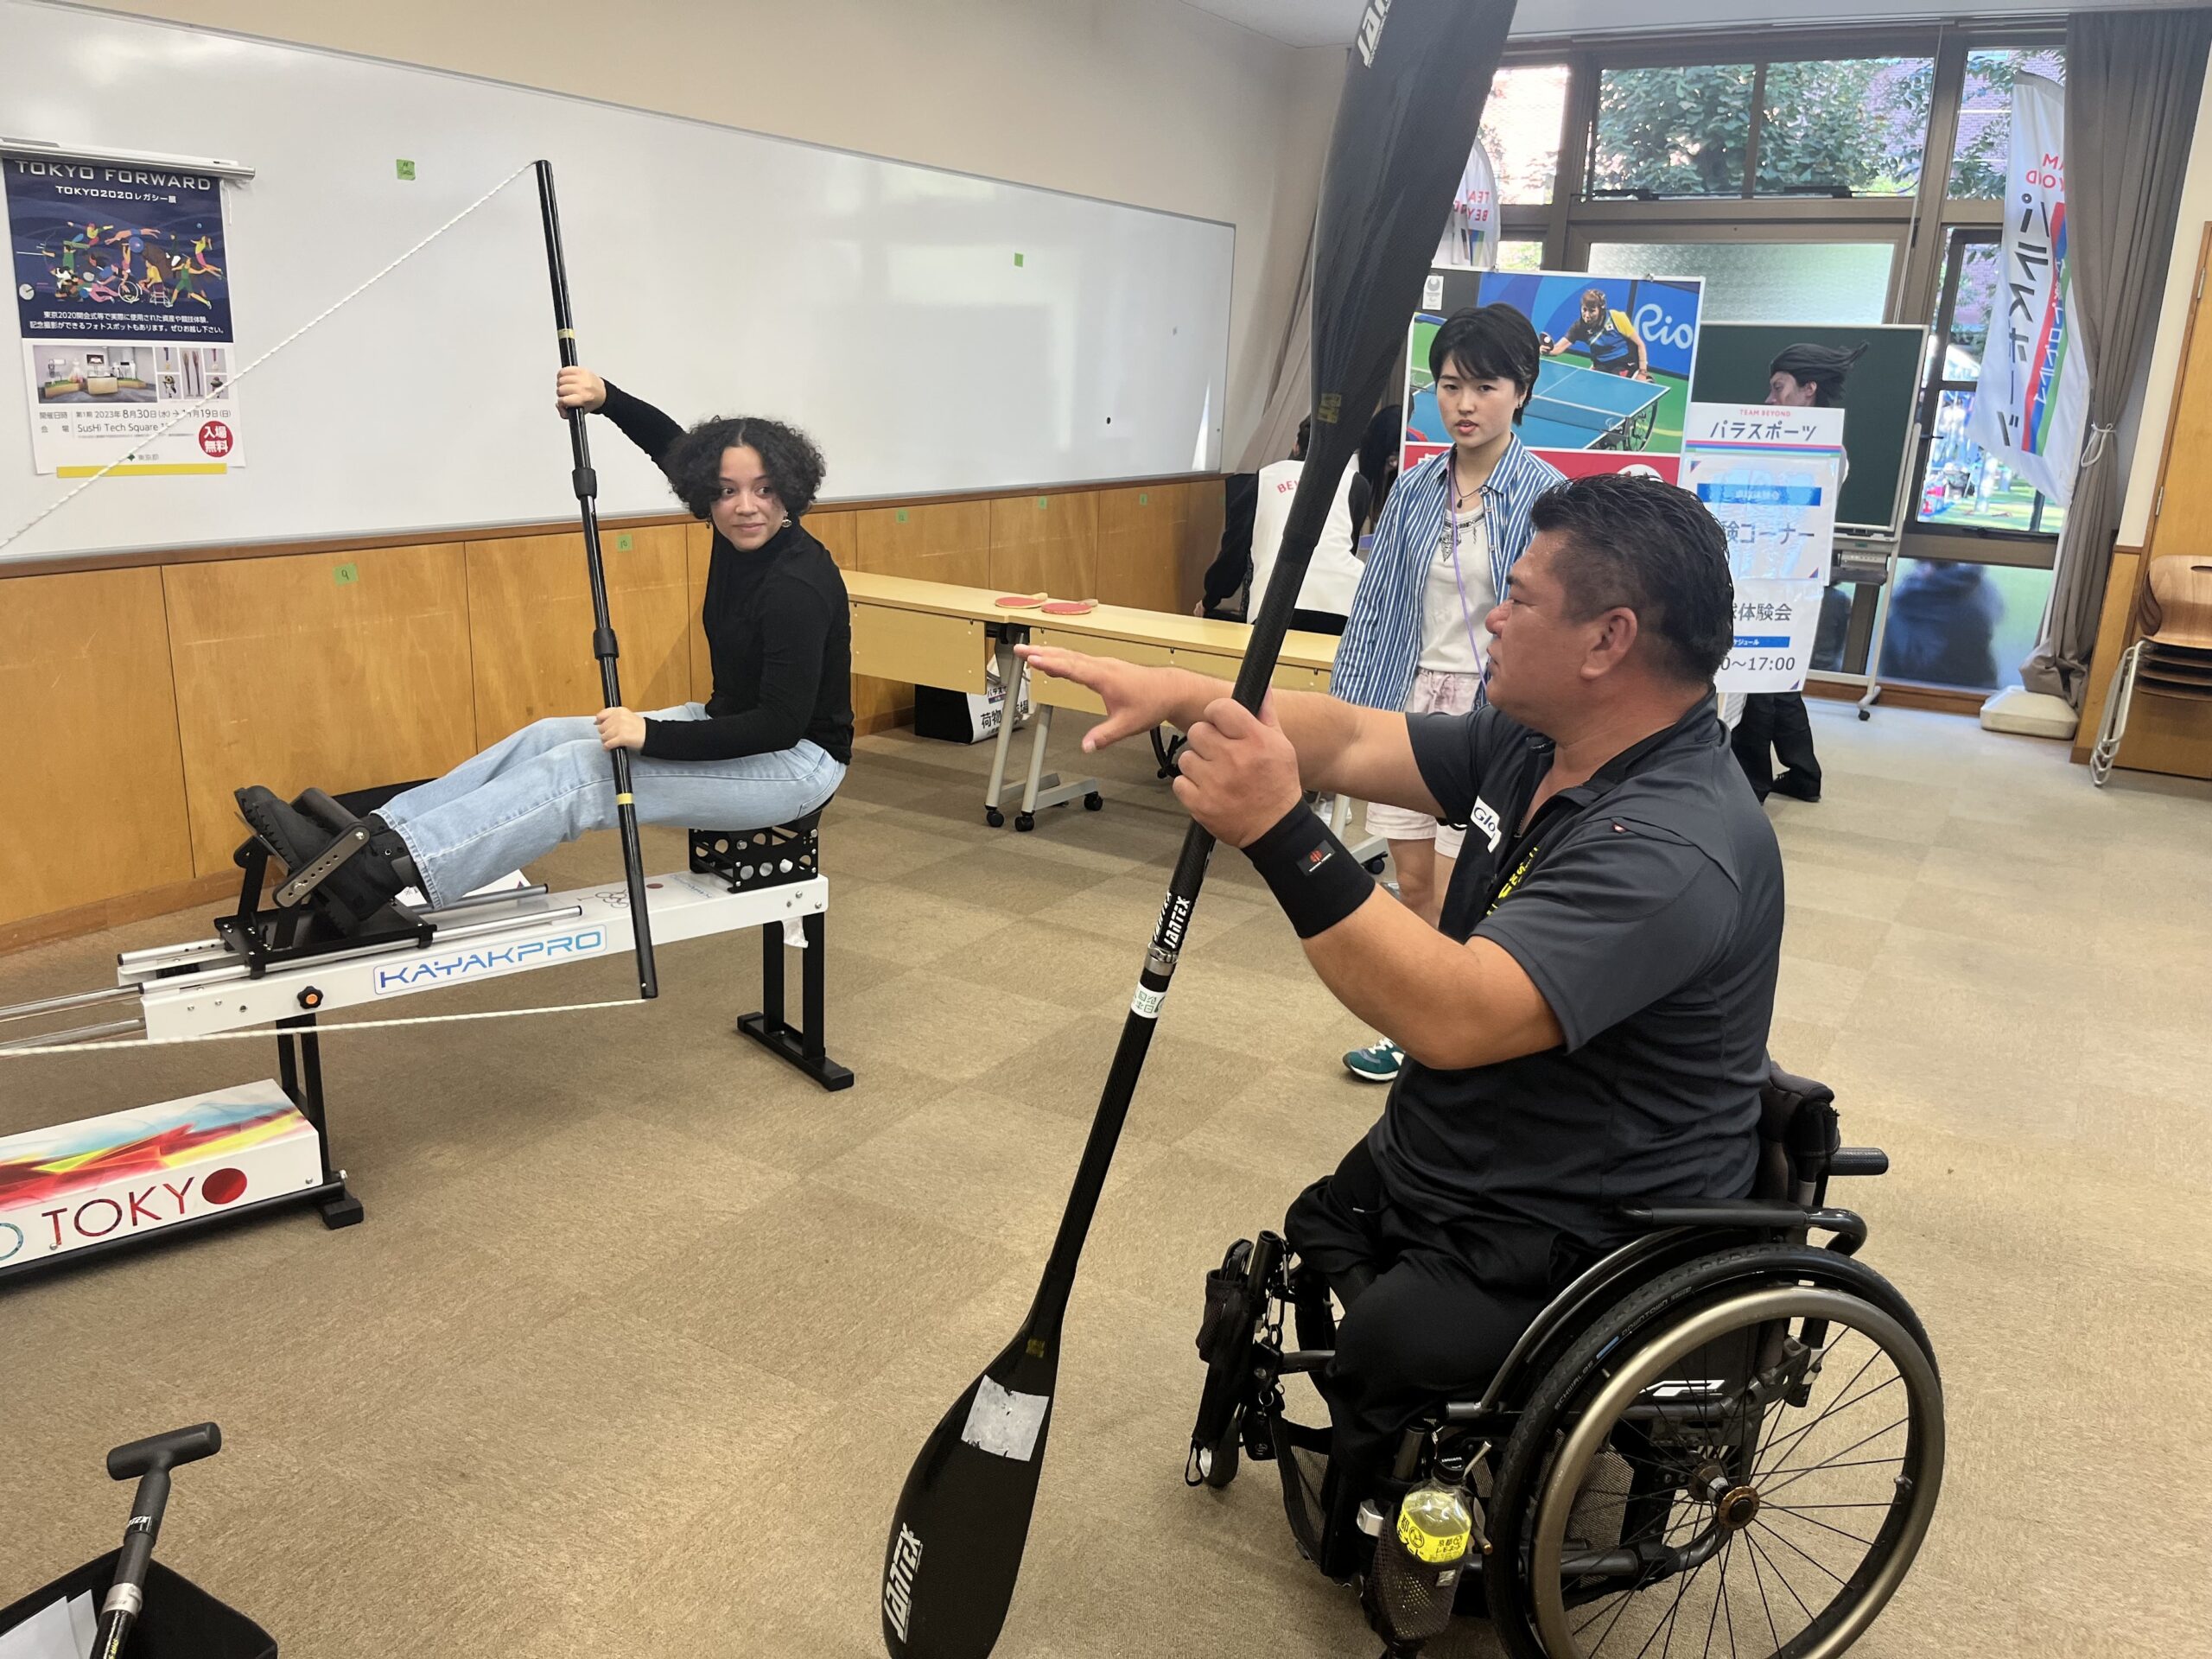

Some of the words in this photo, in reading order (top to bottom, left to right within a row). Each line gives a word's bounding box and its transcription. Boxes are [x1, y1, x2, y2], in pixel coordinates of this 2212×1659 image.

[15, 160, 94, 180] TOKYO
[105, 169, 212, 191] FORWARD
[1633, 303, 1694, 349] Rio
[1761, 410, 1791, 418] BEYOND
[77, 423, 102, 434] SusHi
[104, 423, 126, 433] Tech
[128, 423, 159, 435] Square
[203, 425, 227, 439] 入場
[1710, 420, 1817, 442] パラスポーツ
[204, 440, 229, 454] 無料
[1276, 480, 1298, 493] BE
[1164, 895, 1190, 949] JANTEX
[380, 931, 601, 988] KAYAKPRO
[885, 1522, 922, 1643] JANTEX
